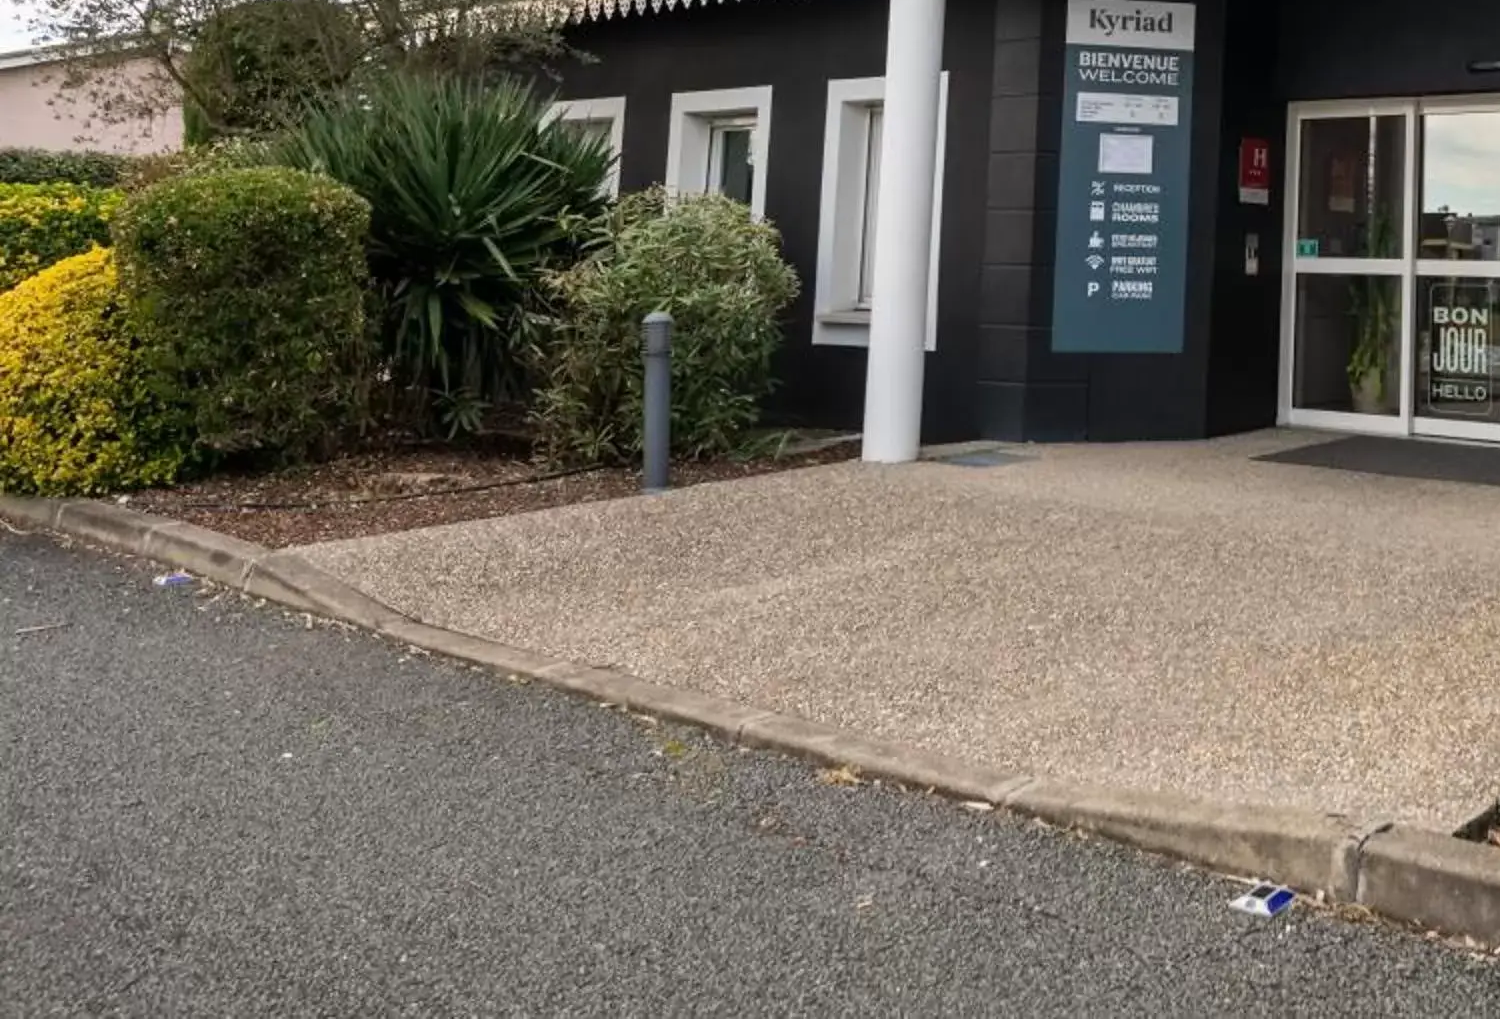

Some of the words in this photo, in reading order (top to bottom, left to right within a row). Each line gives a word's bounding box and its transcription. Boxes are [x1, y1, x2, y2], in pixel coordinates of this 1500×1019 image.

[1089, 8, 1173, 37] Kyriad
[1079, 50, 1179, 72] BIENVENUE
[1079, 68, 1179, 86] WELCOME
[1254, 148, 1267, 168] H
[1111, 212, 1159, 222] ROOMS
[1433, 306, 1488, 325] BON
[1433, 326, 1488, 374] JOUR
[1432, 384, 1487, 401] HELLO
